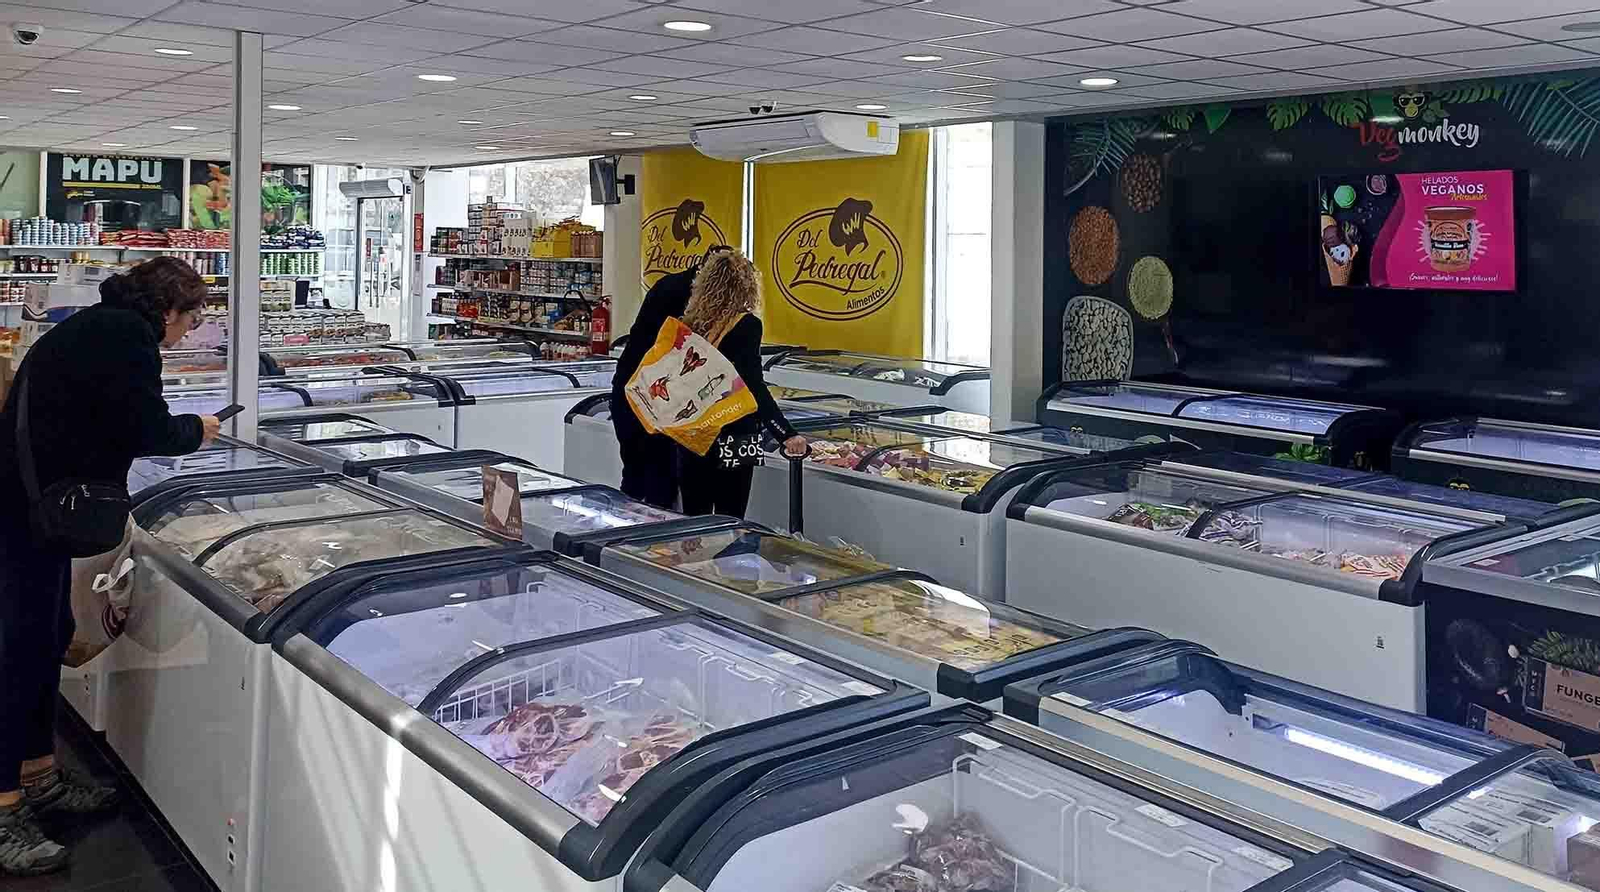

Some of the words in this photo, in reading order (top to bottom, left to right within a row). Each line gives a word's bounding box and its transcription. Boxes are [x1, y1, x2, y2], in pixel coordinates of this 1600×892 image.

[62, 156, 162, 183] MAPU
[1421, 176, 1459, 185] HELADOS
[1421, 184, 1484, 195] VEGANOS
[648, 225, 668, 243] Del
[797, 228, 823, 248] Del
[644, 243, 703, 271] Pedrega
[846, 286, 885, 310] Alimentos
